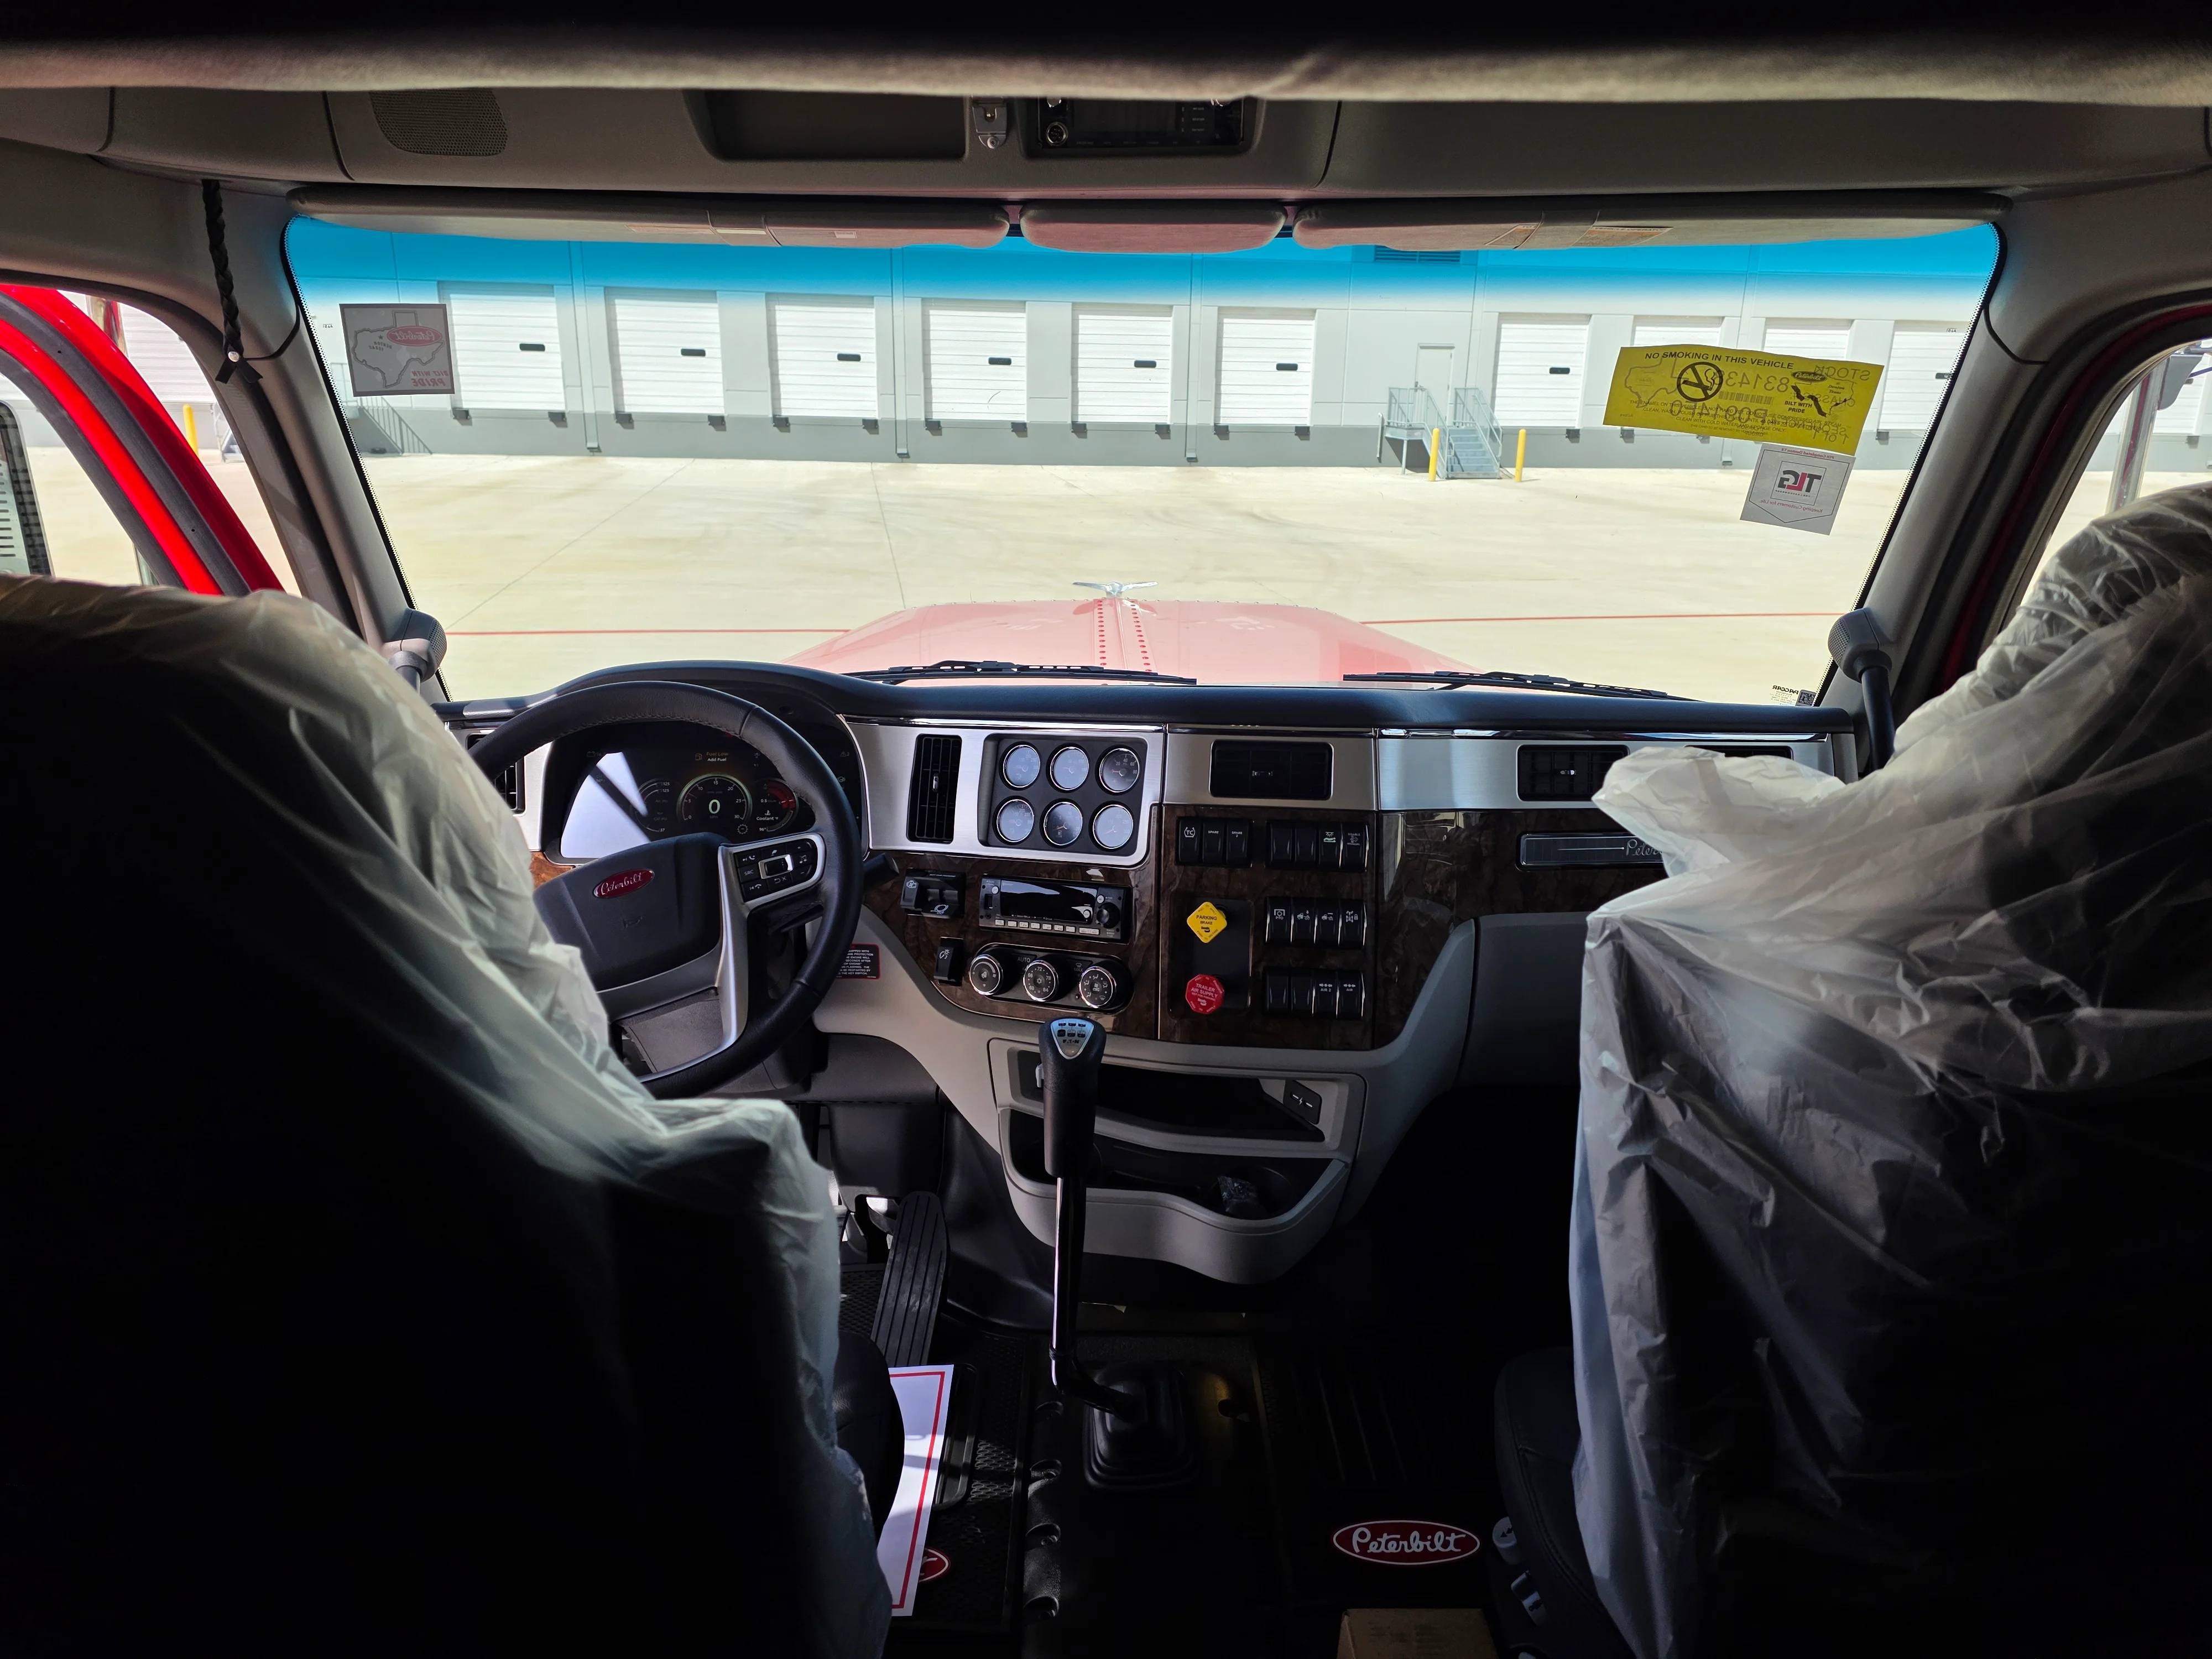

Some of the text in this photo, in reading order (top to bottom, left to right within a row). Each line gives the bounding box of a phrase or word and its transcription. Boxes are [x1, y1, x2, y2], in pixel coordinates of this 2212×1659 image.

[1662, 351, 1709, 360] SMOKING
[1725, 356, 1747, 364] THIS
[1750, 358, 1794, 369] VEHICLE
[1794, 372, 1825, 381] Peterbilt
[1777, 415, 1813, 423] COMPRESSED
[708, 799, 721, 814] 0
[1626, 839, 1662, 856] Peter
[601, 871, 646, 895] Peterbilt
[1196, 983, 1215, 993] TRAILER
[1199, 990, 1218, 998] SUPPLY
[1352, 1527, 1467, 1553] Peterbilt
